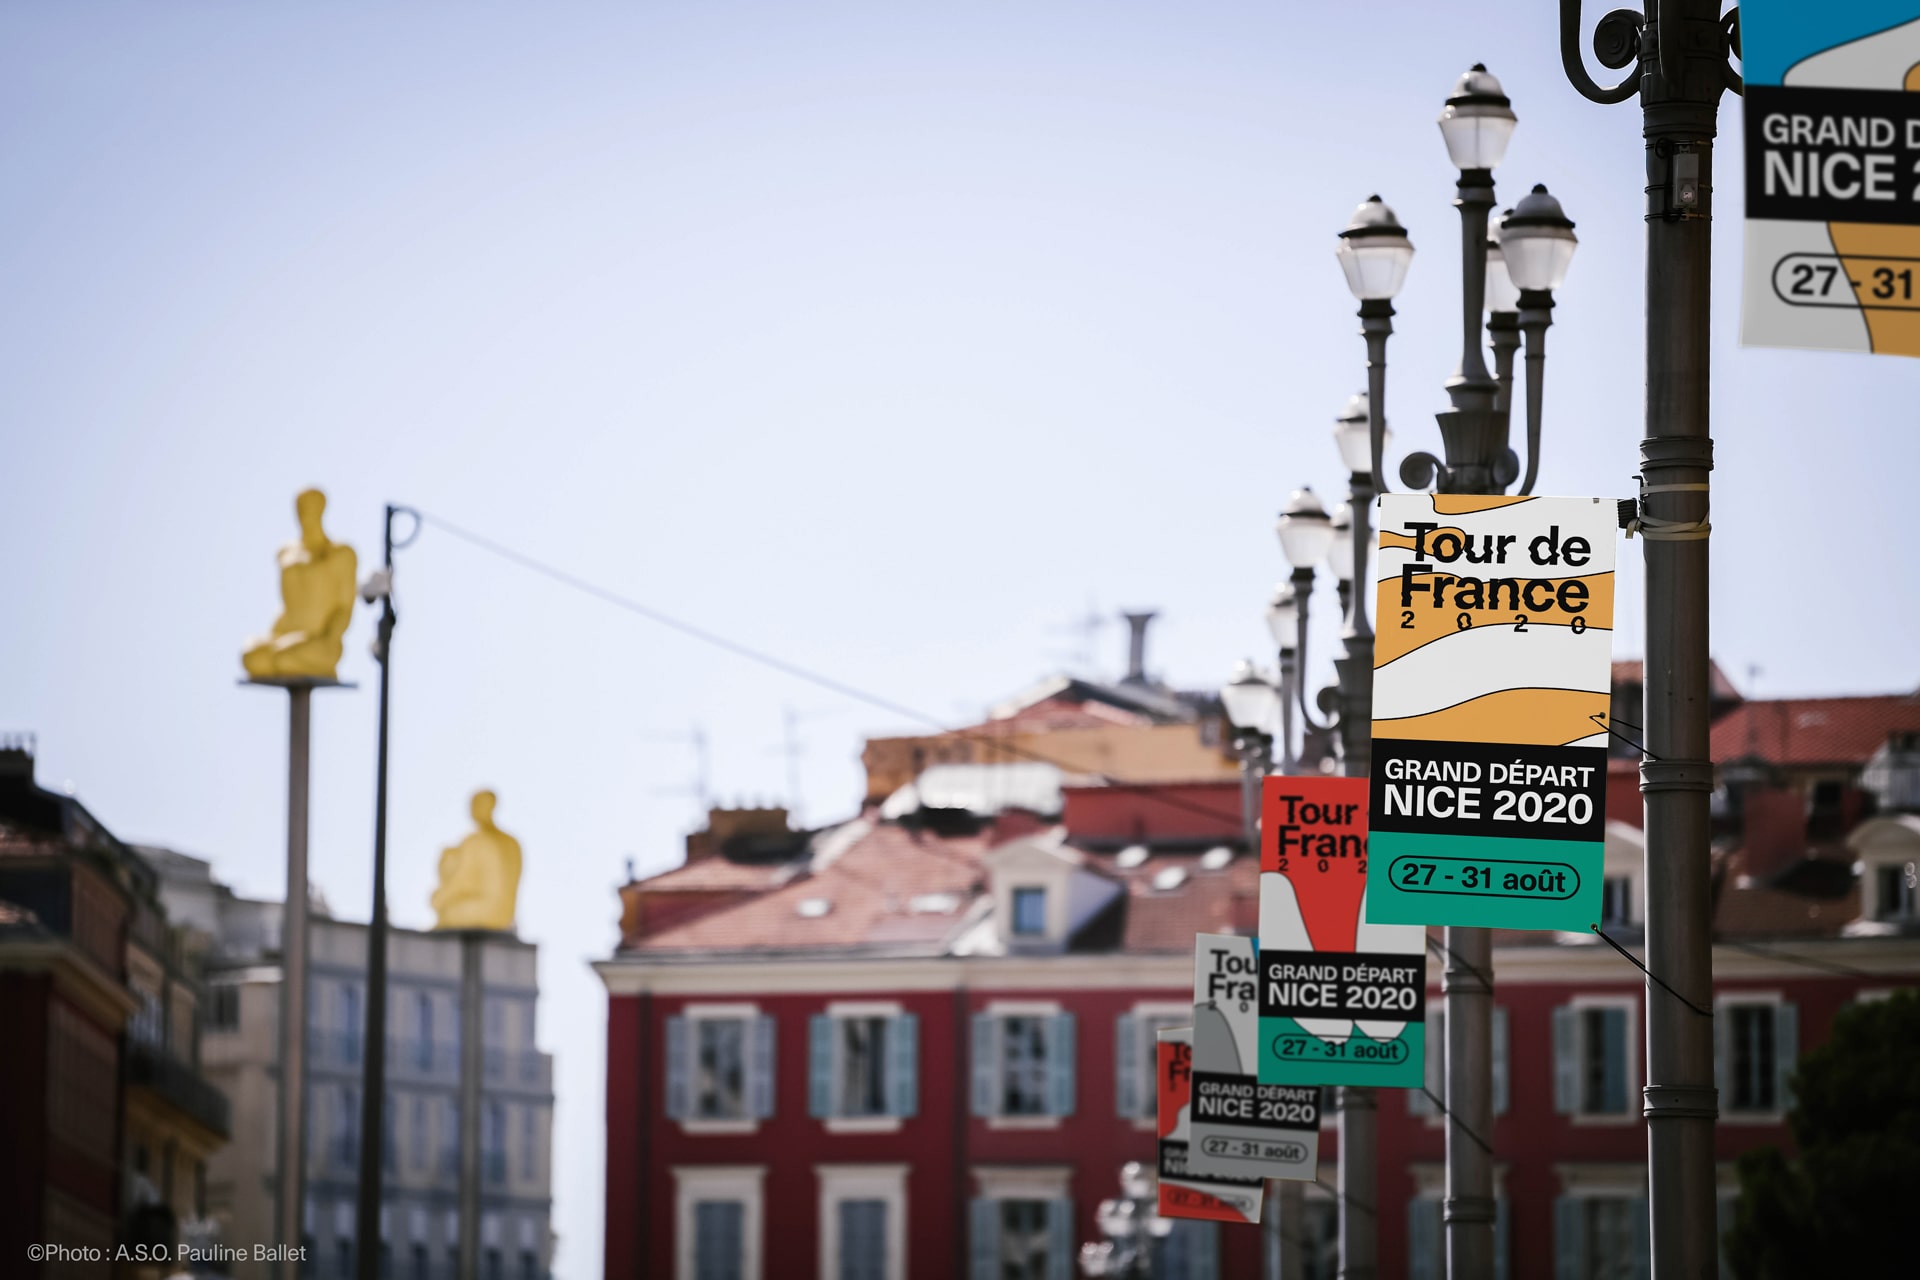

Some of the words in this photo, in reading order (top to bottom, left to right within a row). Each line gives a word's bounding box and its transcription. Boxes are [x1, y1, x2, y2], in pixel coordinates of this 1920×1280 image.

[1763, 113, 1896, 148] GRAND
[1764, 150, 1897, 200] NICE
[1791, 264, 1838, 296] 27
[1872, 267, 1912, 300] 31
[1403, 522, 1517, 564] Tour
[1528, 525, 1592, 567] de
[1401, 563, 1590, 613] France
[1384, 758, 1482, 783] GRAND
[1489, 759, 1596, 788] DÉPART
[1279, 795, 1359, 825] Tour
[1384, 783, 1482, 819] NICE
[1493, 789, 1593, 825] 2020
[1278, 824, 1368, 858] Fran
[1402, 863, 1437, 886] 27
[1461, 866, 1492, 889] 31
[1503, 869, 1567, 893] août
[1268, 963, 1338, 982] GRAND
[1343, 963, 1418, 984] DÉPART
[1268, 982, 1338, 1008] NICE
[1345, 985, 1417, 1011] 2020
[1282, 1039, 1307, 1056] 27
[1324, 1040, 1346, 1058] 31
[1353, 1042, 1399, 1060] août
[1198, 1081, 1254, 1098] GRAND
[1256, 1084, 1317, 1103] DÉPART
[1198, 1096, 1254, 1119] NICE
[1259, 1101, 1316, 1123] 2020
[1208, 1140, 1228, 1153] 27
[1241, 1142, 1259, 1156] 31
[1264, 1144, 1300, 1160] août
